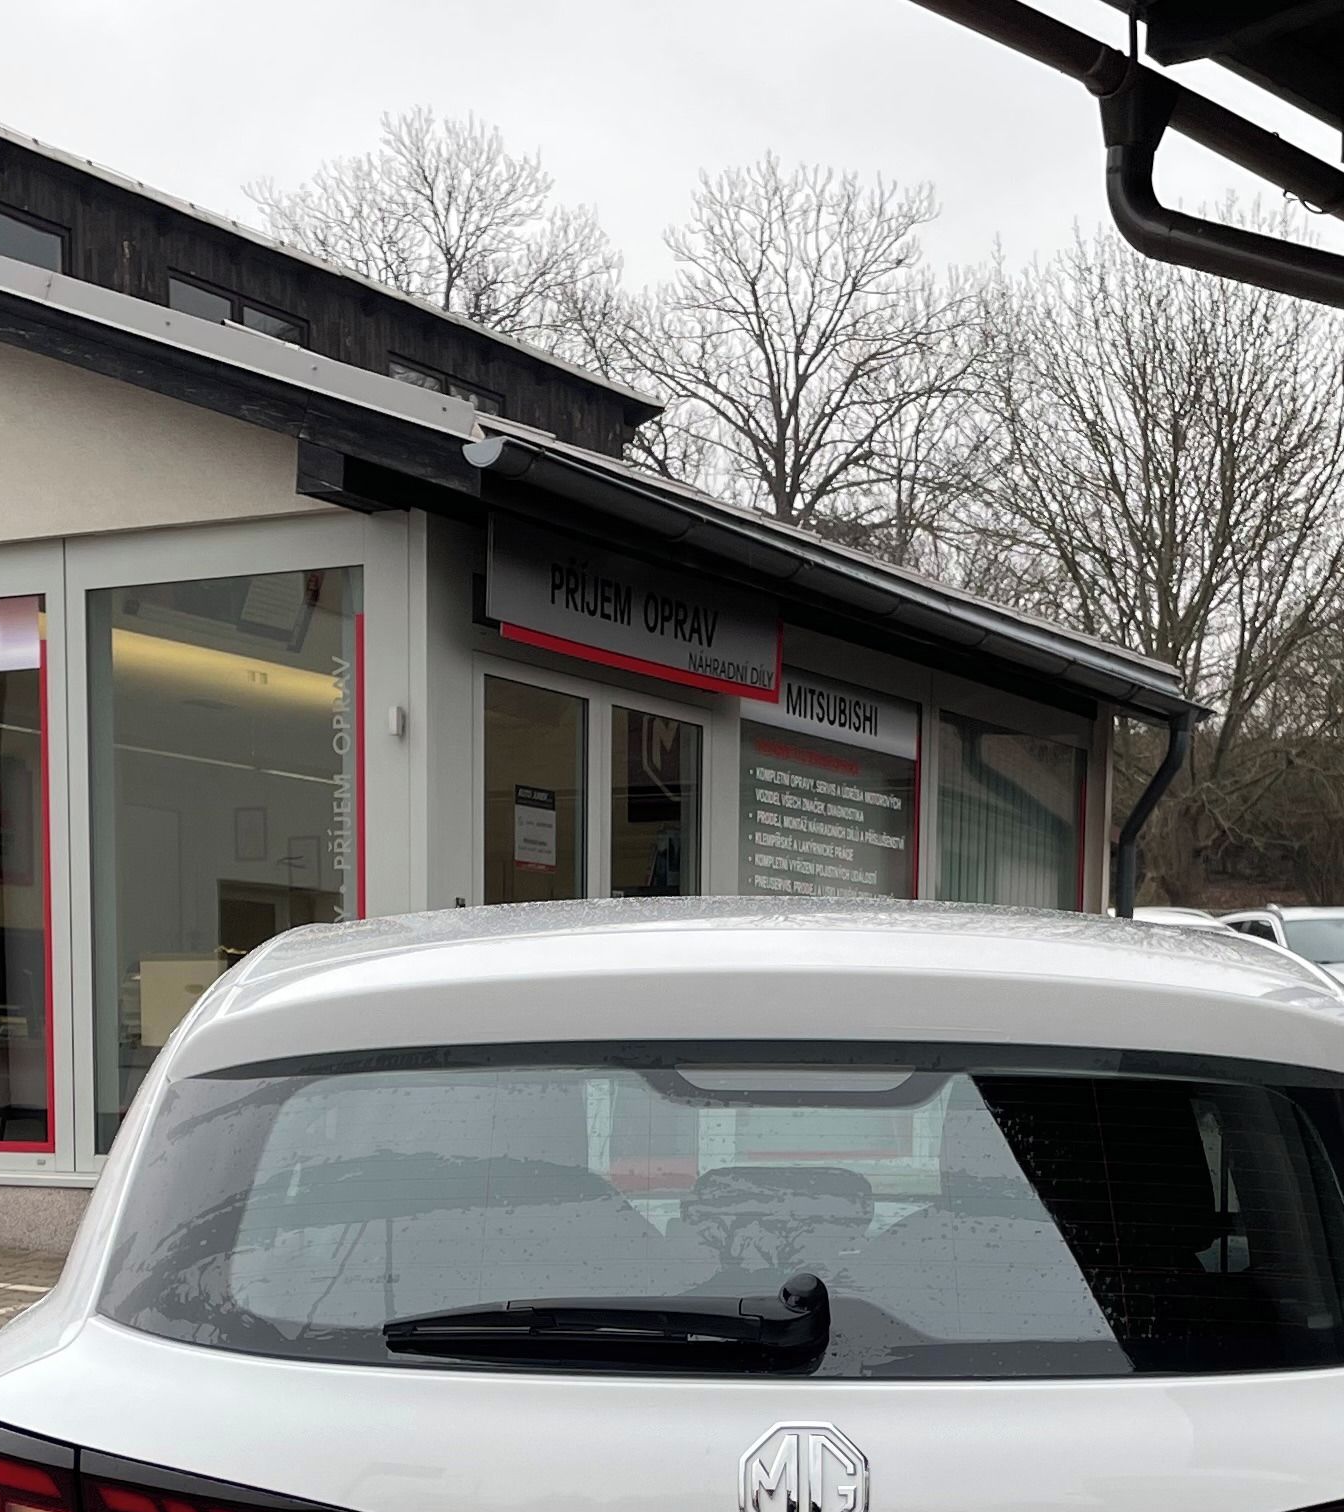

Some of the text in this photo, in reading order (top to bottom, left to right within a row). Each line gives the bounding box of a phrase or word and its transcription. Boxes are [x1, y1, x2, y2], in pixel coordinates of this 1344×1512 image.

[550, 560, 719, 648] PŘÍJEM OPRAV
[688, 651, 775, 688] NÁHRADNÍ DÍLY
[786, 683, 878, 736] MITSUBISHI
[328, 656, 351, 870] PŘÍJEM OPRAV
